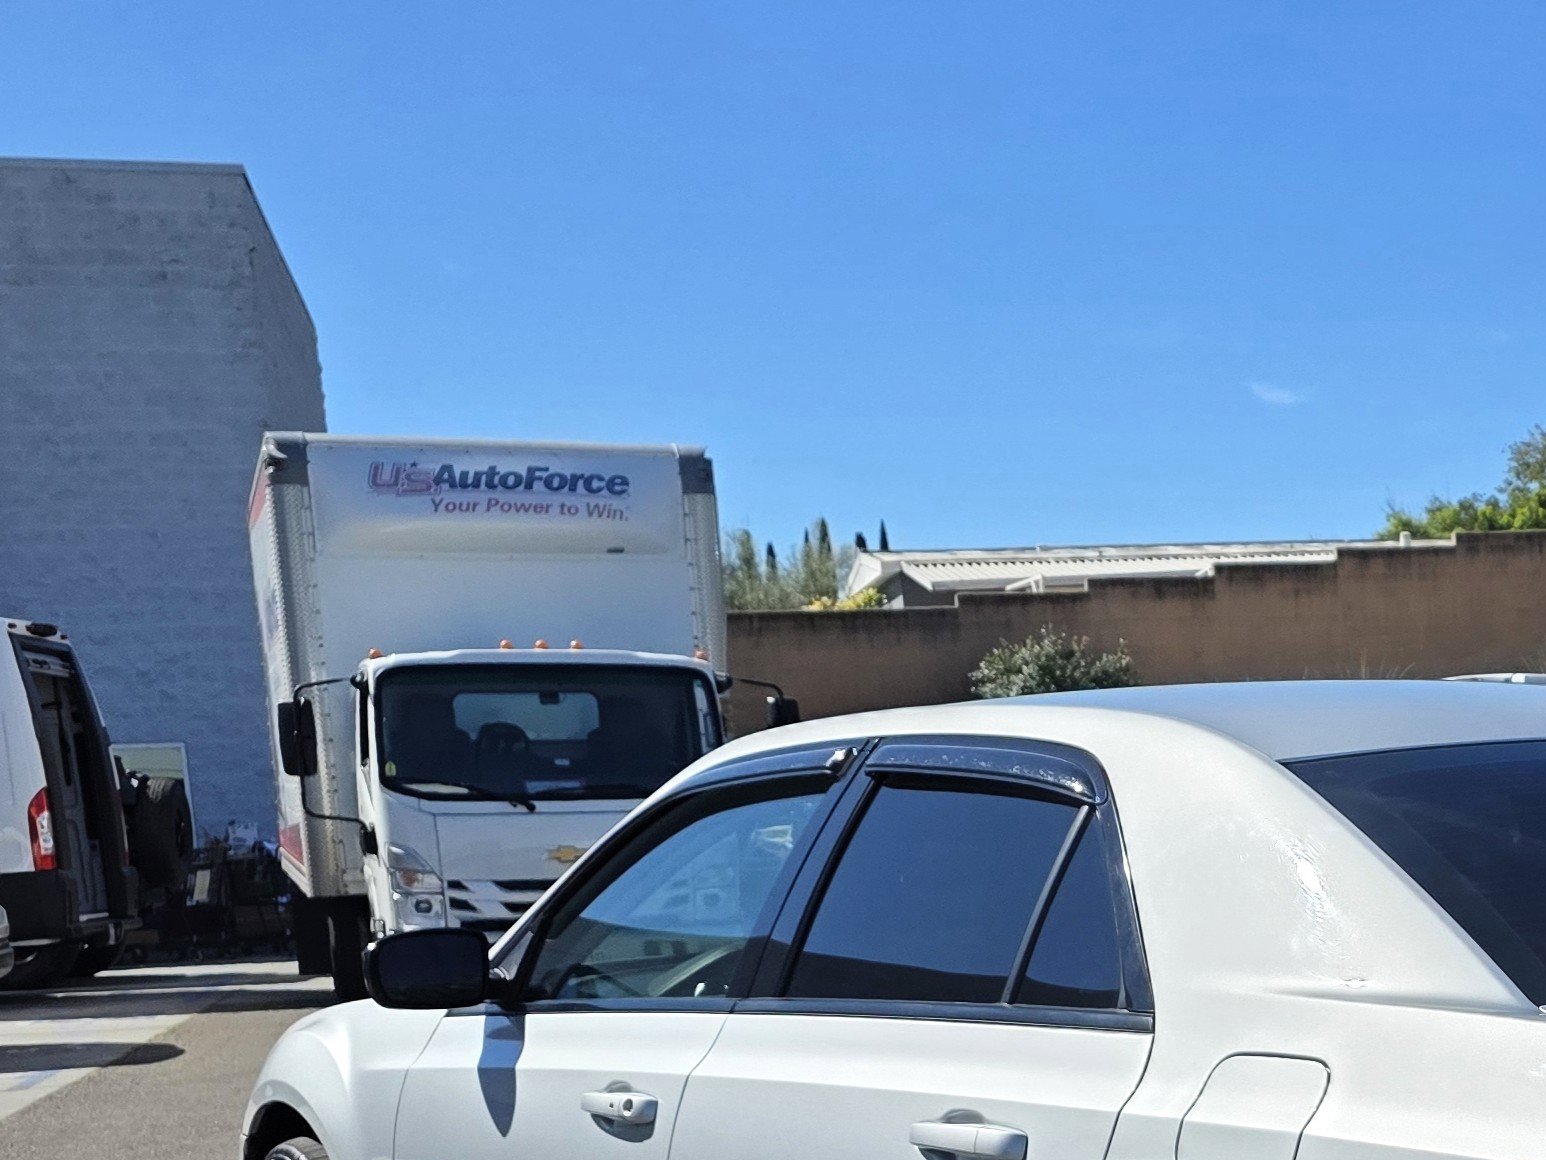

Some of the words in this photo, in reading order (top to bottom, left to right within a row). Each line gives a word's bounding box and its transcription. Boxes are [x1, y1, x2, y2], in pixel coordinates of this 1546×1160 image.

[431, 498, 479, 514] Your
[486, 498, 550, 516] Power
[559, 502, 579, 517] to
